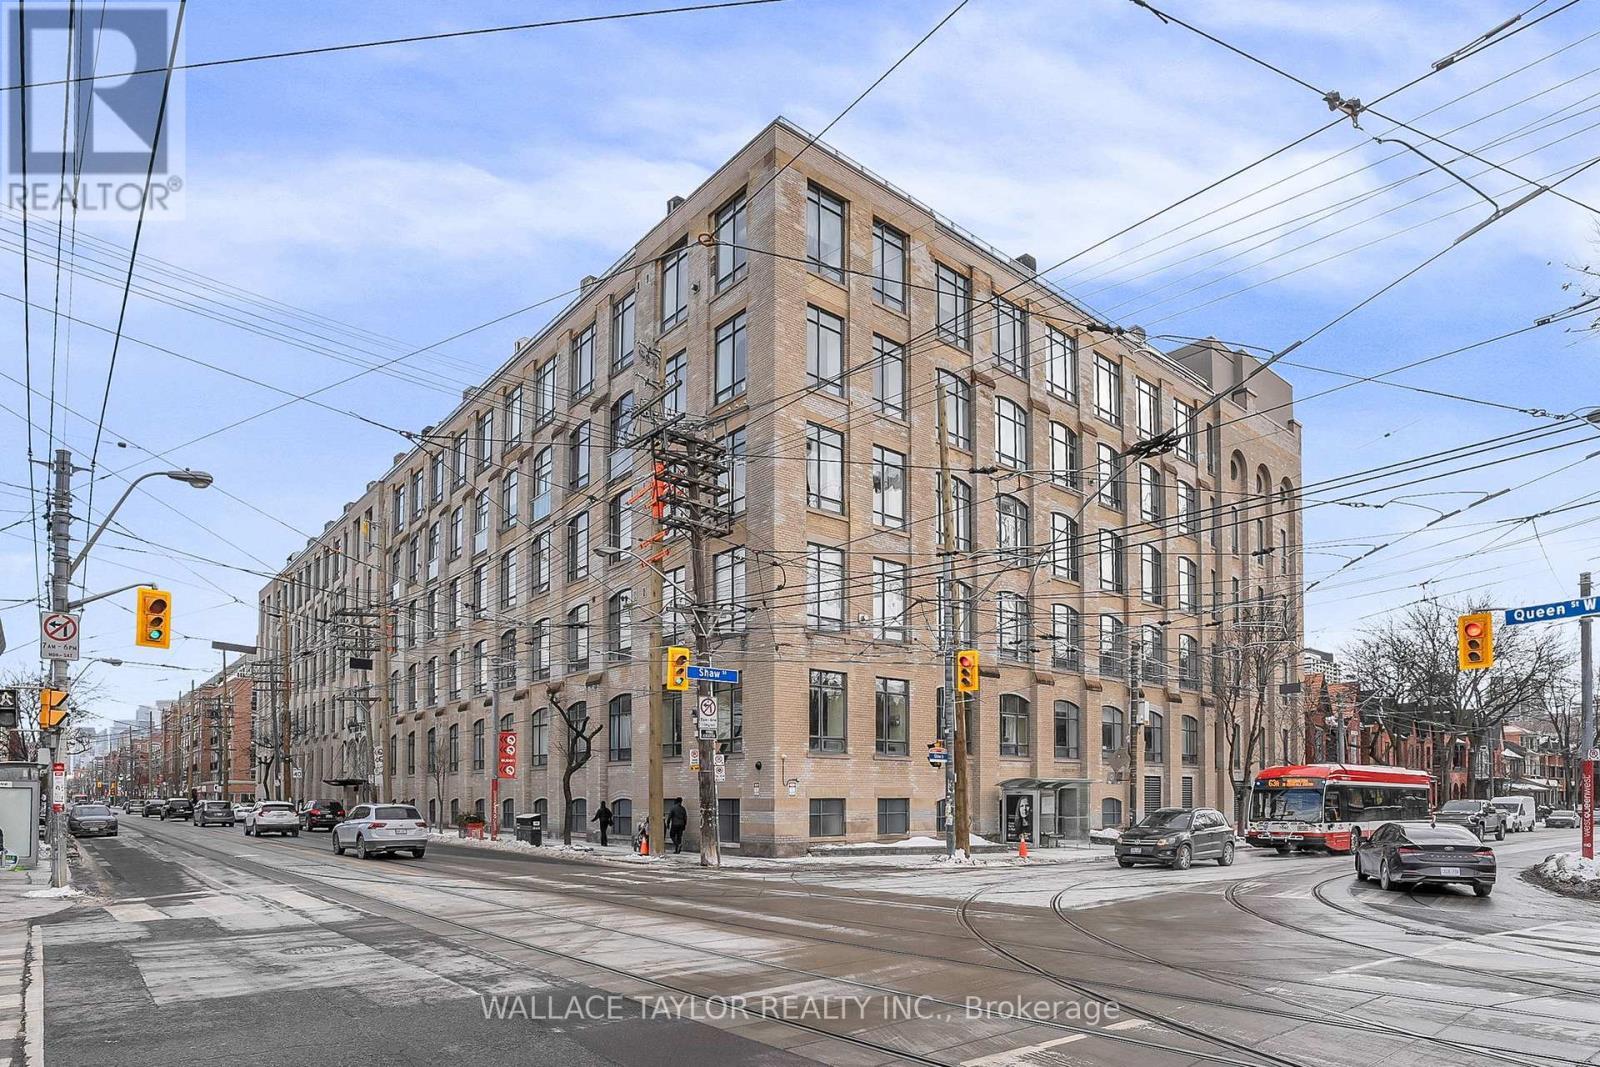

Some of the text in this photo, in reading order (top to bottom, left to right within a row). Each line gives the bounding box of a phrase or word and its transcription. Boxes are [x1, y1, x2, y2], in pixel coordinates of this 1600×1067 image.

[1514, 598, 1596, 621] Queen St W
[699, 669, 721, 678] Shaw
